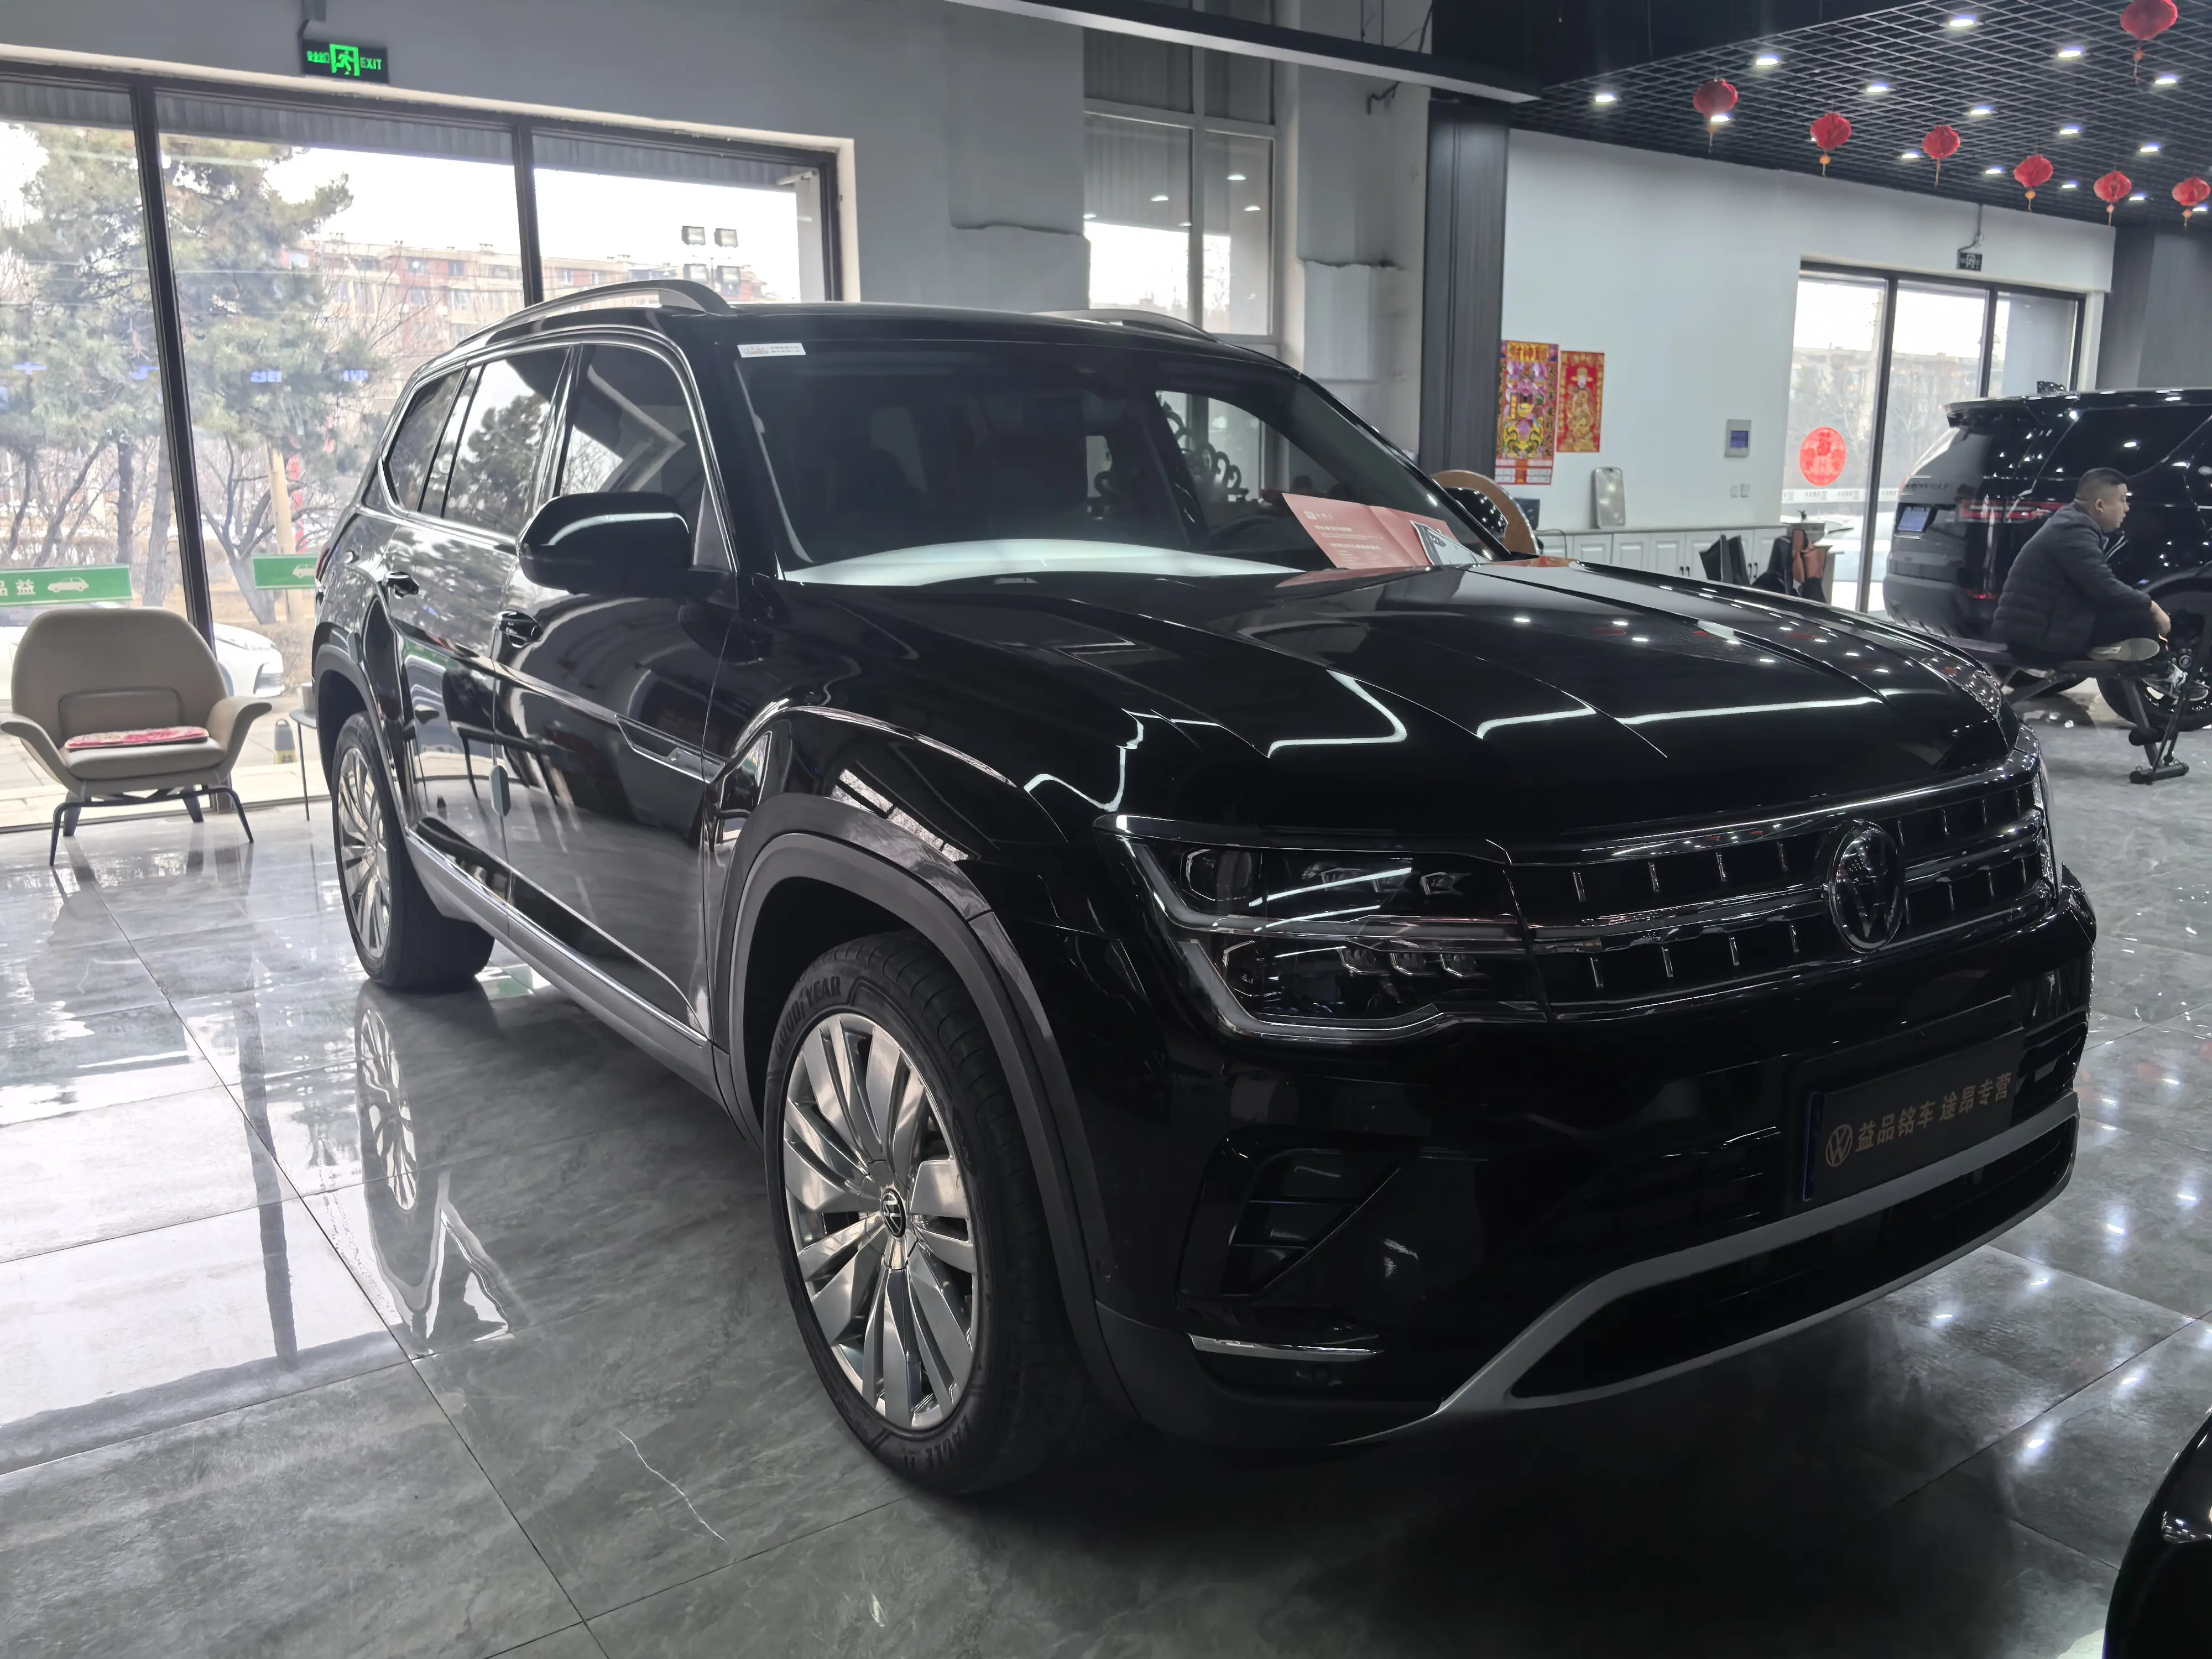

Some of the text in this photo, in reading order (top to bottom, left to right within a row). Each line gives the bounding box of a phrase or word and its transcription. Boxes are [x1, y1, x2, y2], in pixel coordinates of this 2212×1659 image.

[360, 56, 382, 70] EXIT
[1855, 1072, 2013, 1153] 益品铭车 途昂专营
